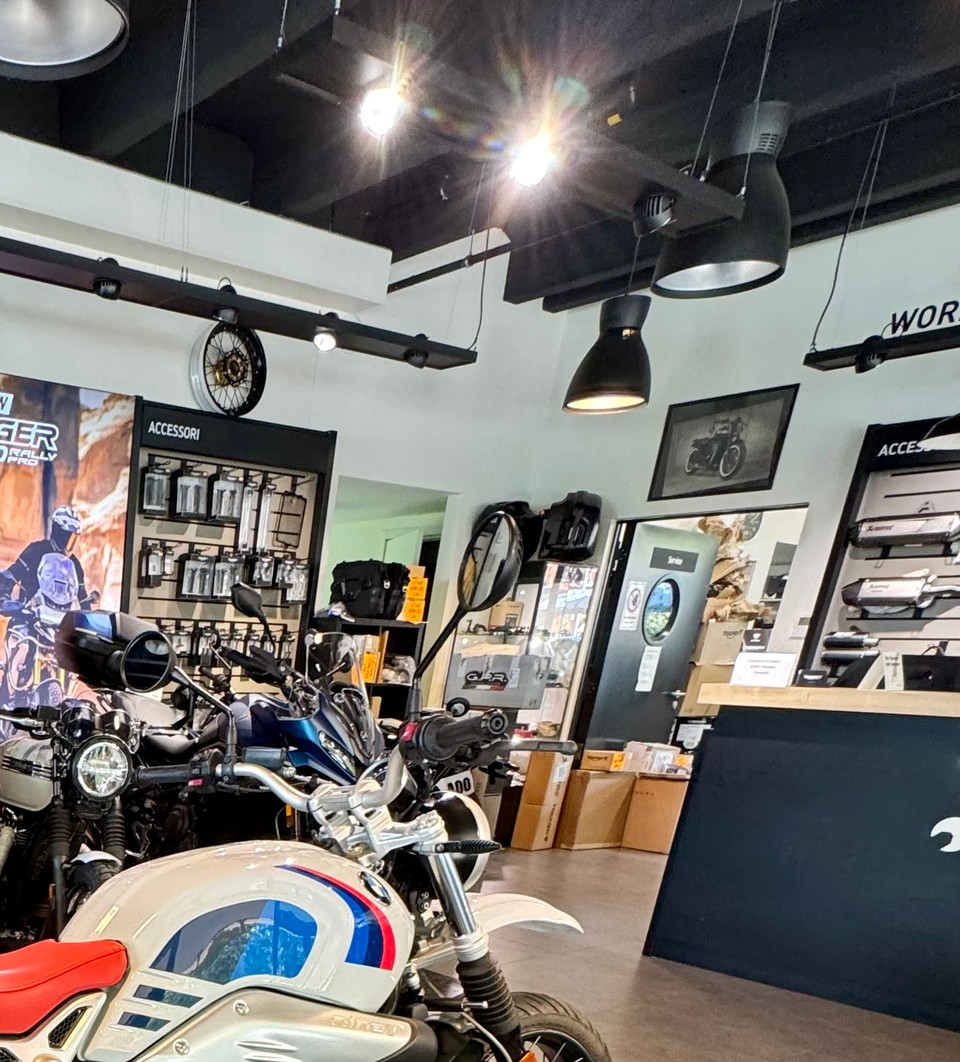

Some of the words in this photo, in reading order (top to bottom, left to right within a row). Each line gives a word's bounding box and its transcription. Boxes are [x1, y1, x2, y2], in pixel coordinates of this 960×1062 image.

[891, 300, 960, 335] WOR
[147, 421, 201, 441] ACCESSORI
[9, 447, 58, 461] RALLY
[7, 456, 39, 467] PRO
[667, 555, 684, 566] Service
